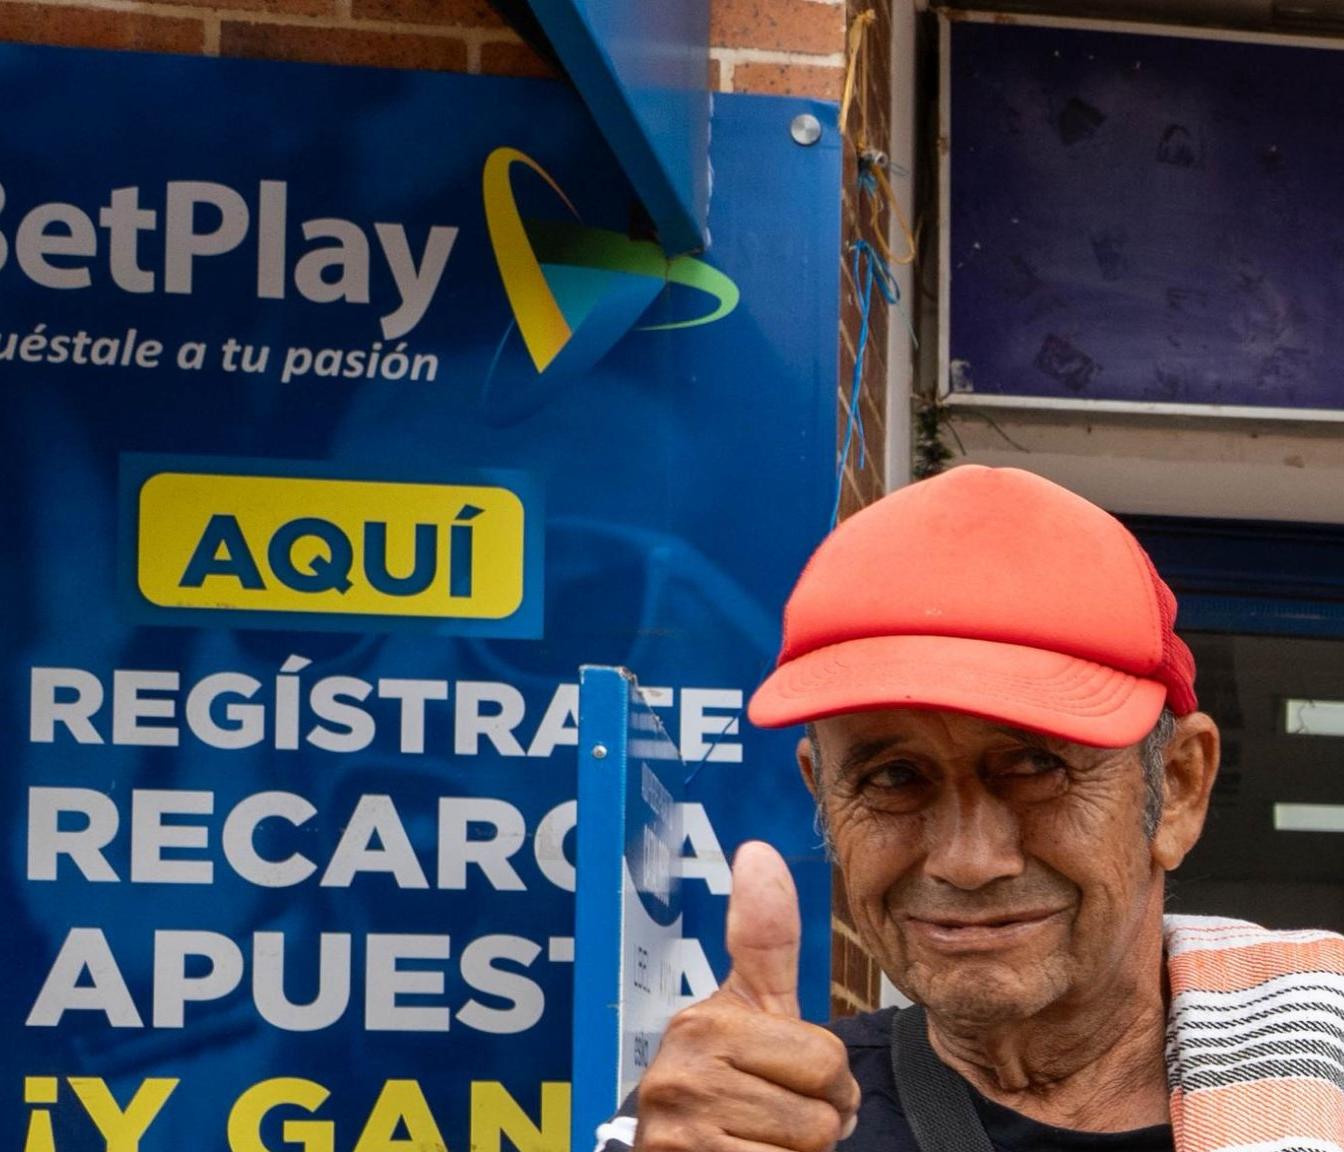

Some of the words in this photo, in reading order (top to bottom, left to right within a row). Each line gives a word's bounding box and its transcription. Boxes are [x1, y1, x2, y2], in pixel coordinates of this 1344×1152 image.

[0, 176, 459, 341] etPlay
[177, 340, 207, 371] a
[221, 337, 269, 373] tu
[282, 333, 439, 383] pasión
[178, 504, 486, 600] AQUÍ
